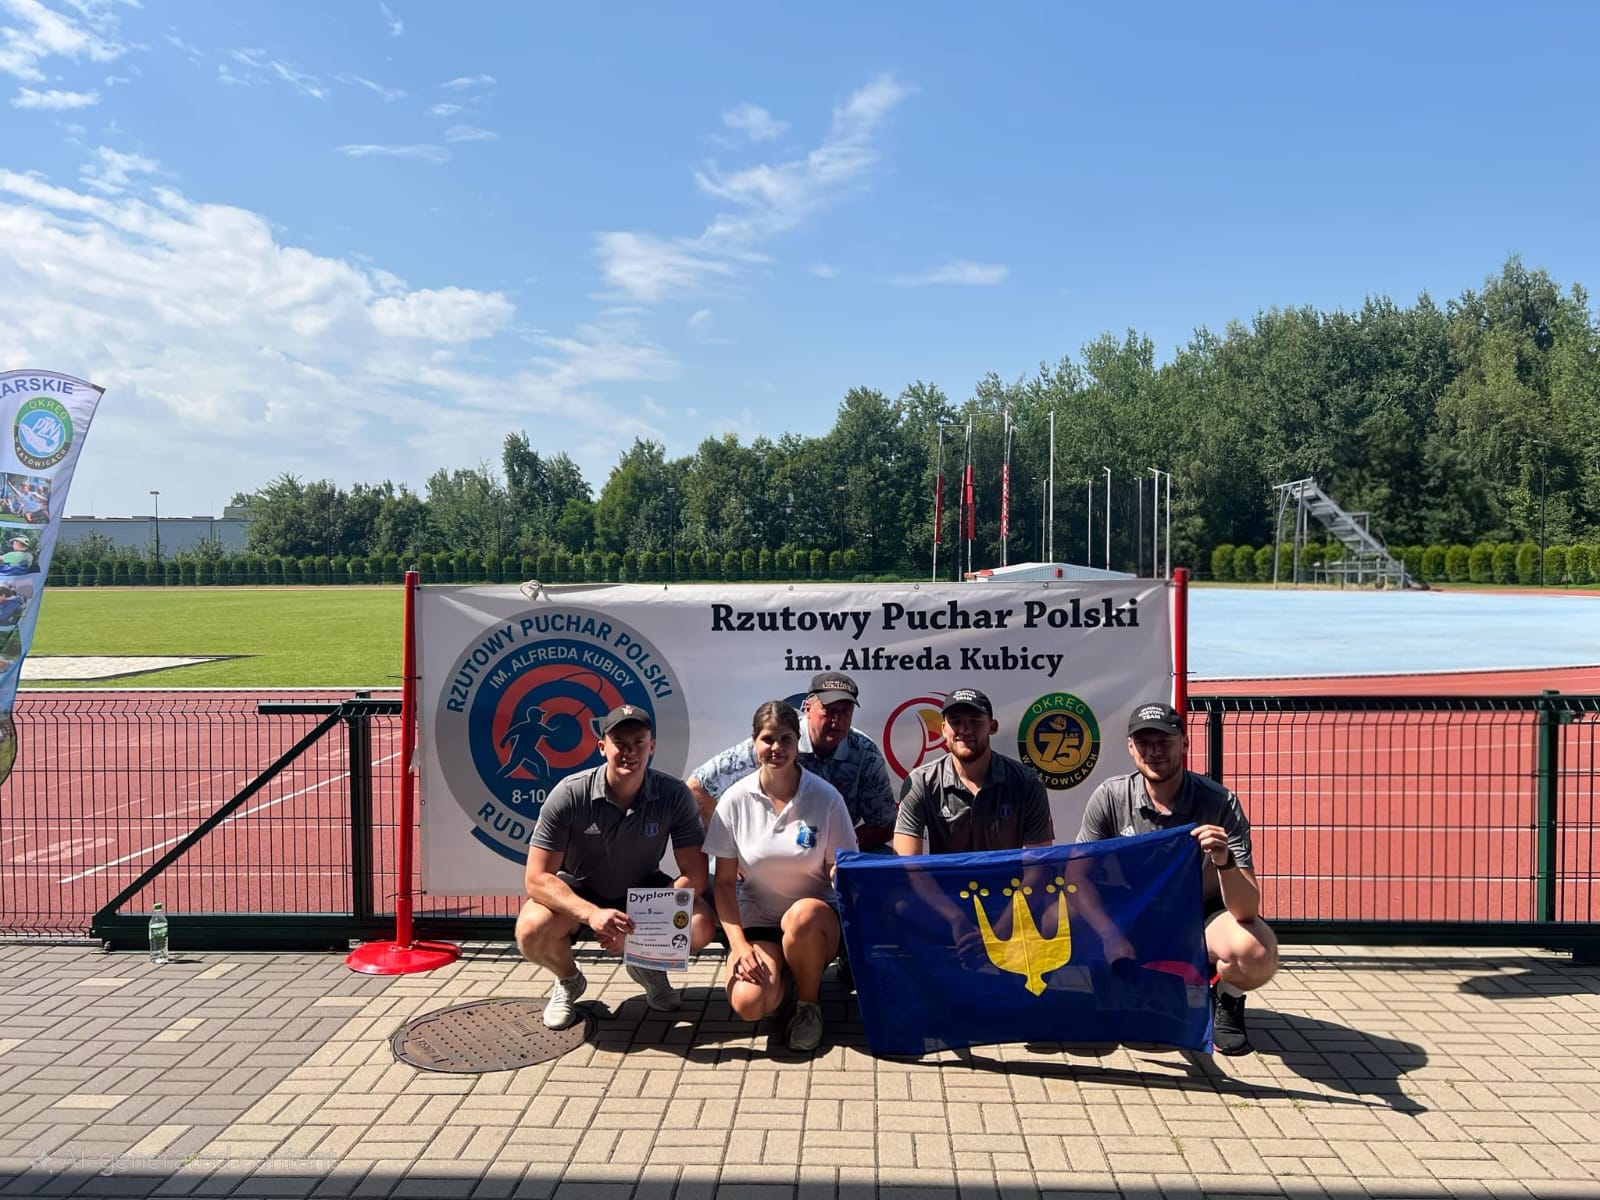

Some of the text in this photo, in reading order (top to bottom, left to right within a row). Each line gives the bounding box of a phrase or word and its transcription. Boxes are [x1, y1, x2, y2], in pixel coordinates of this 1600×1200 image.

[0, 377, 74, 398] ARSKIE
[711, 598, 1139, 640] Rzutowy Puchar Polski
[446, 613, 673, 713] RZUTOWY PUCHAR POLSKI
[489, 646, 634, 689] IM. ALFREDA KUBICY
[784, 646, 1064, 678] im. Alfreda Kubicy
[1038, 732, 1081, 767] 75
[629, 891, 674, 904] Dyplom
